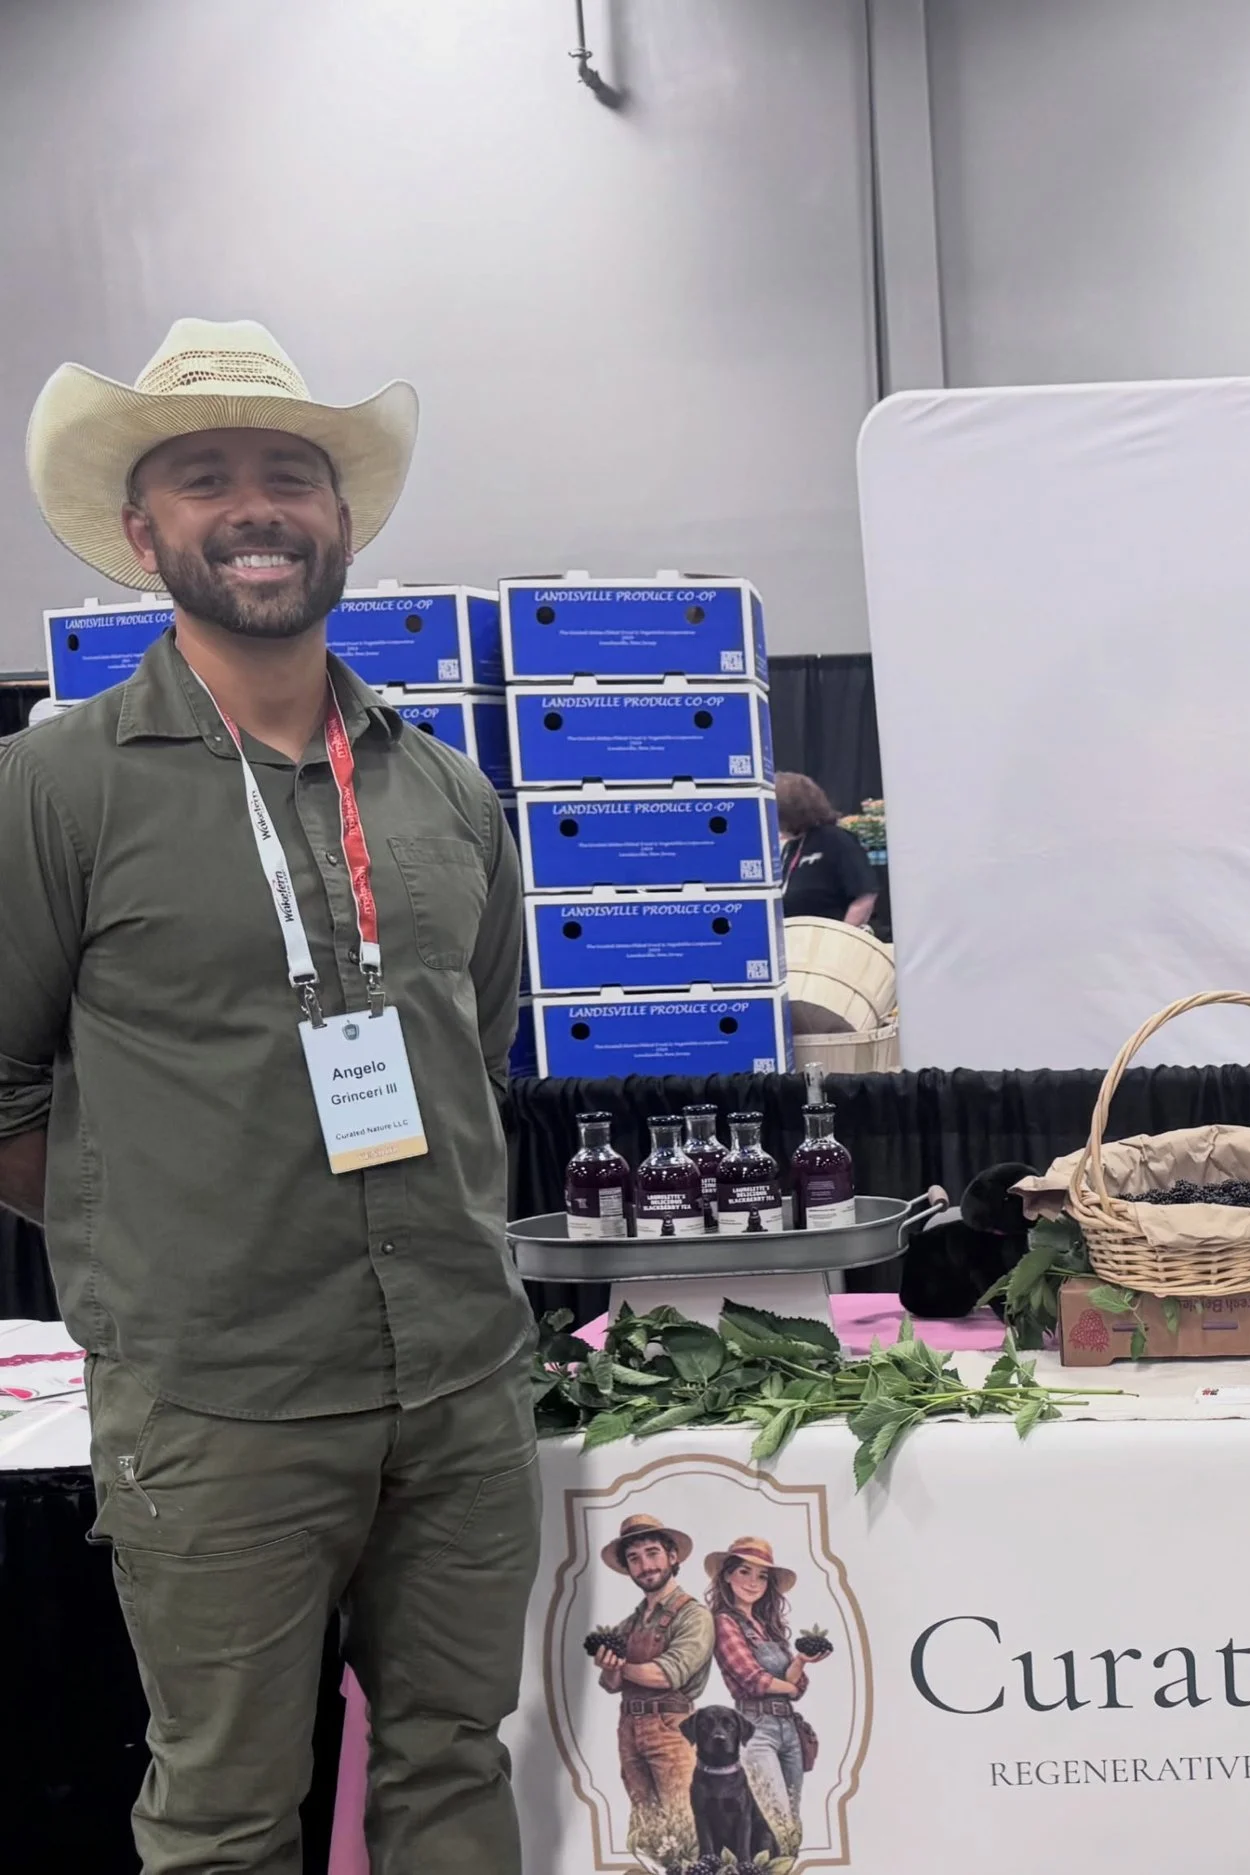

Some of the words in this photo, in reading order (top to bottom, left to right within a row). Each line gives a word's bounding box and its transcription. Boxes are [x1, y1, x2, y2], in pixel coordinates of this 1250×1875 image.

[534, 590, 612, 602] LANDISVILLE
[615, 590, 673, 602] PRODUCE
[341, 600, 393, 613] PRODUCE
[65, 615, 114, 630] LANDISVILLE
[116, 614, 154, 626] PRODUCE
[155, 612, 176, 623] CO-O
[541, 696, 620, 709] LANDISVILLE
[623, 696, 682, 708] PRODUCE
[552, 803, 630, 816] LANDISVILLE
[634, 802, 692, 814] PRODUCE
[274, 870, 295, 922] Wakefern
[561, 904, 639, 918] LANDISVILLE
[642, 904, 700, 915] PRODUCE
[569, 1004, 647, 1018] LANDISVILLE
[650, 1002, 707, 1015] PRODUCE
[332, 1060, 386, 1081] Angelo
[330, 1085, 383, 1105] Grinceri
[386, 1082, 398, 1095] III
[335, 1128, 366, 1141] Curated
[366, 1123, 392, 1134] Nature
